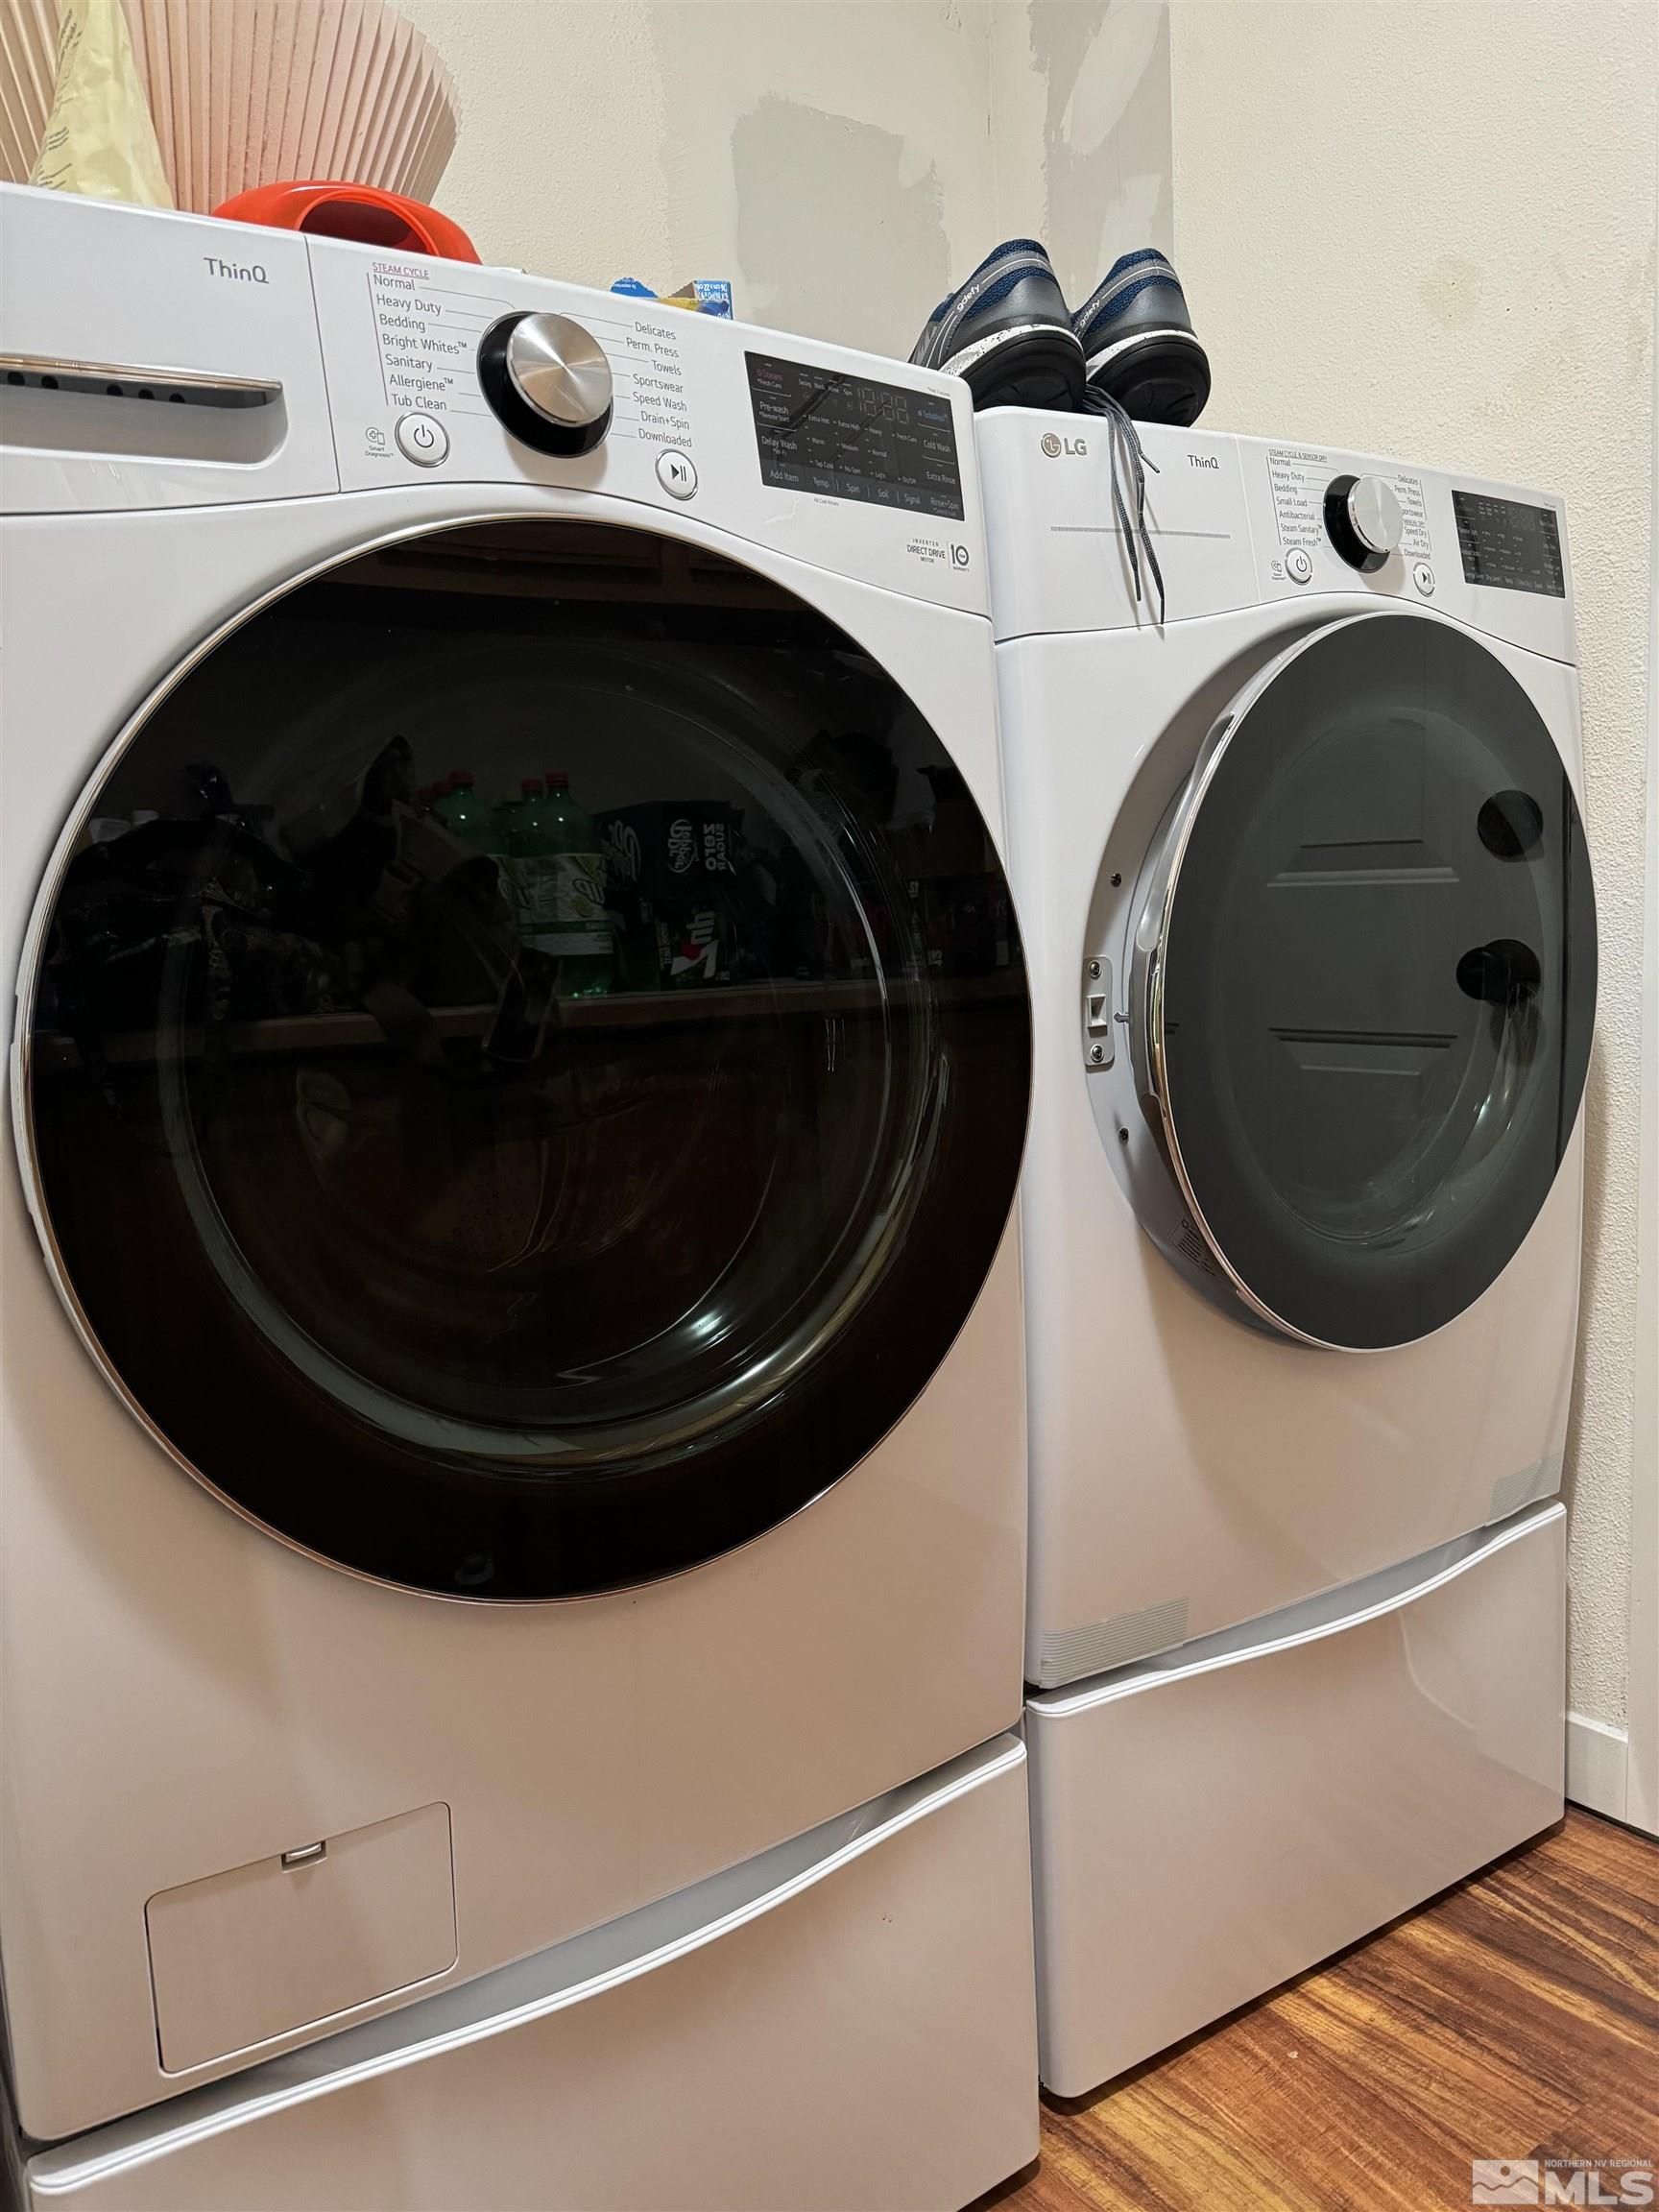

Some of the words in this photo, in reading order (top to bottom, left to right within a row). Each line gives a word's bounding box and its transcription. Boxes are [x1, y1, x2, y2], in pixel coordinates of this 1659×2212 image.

[203, 257, 270, 284] ThinQ
[372, 262, 401, 274] STEAM
[403, 267, 429, 278] CYCLE
[373, 274, 415, 290] Normal
[376, 294, 411, 312] Heavy
[415, 299, 442, 317] Duty
[956, 284, 980, 311] gdefy
[1080, 300, 1100, 326] gdefy
[379, 313, 425, 333] Bedding
[635, 322, 676, 340] Delicates
[383, 333, 418, 350] Bright
[627, 337, 652, 352] Perm.
[654, 343, 679, 358] Press
[385, 353, 433, 373] Sanitary
[651, 359, 682, 375] Towels
[633, 373, 684, 393] Sportswear
[392, 394, 412, 406] Tub
[416, 396, 446, 411] Clean
[633, 391, 661, 406] Speed
[662, 397, 686, 411] Wash
[640, 410, 689, 430] Drain+Spin
[638, 428, 691, 447] Downloaded
[1064, 438, 1088, 456] LG
[1187, 454, 1219, 469] ThinQ
[1270, 457, 1291, 467] Normal
[1272, 470, 1289, 481] Heavy
[1290, 471, 1305, 482] Duty
[846, 483, 860, 493] Spin
[1274, 484, 1298, 495] Bedding
[1276, 496, 1292, 505] Small
[1279, 511, 1314, 519] Antibacterial
[1402, 509, 1423, 517] portswear
[1281, 523, 1297, 532] Steam
[1405, 527, 1418, 536] Speed
[1283, 537, 1301, 545] Steam
[907, 544, 927, 555] DIRECT
[928, 548, 946, 559] DRIVE
[950, 543, 969, 566] 10
[1405, 549, 1431, 560] Downloaded
